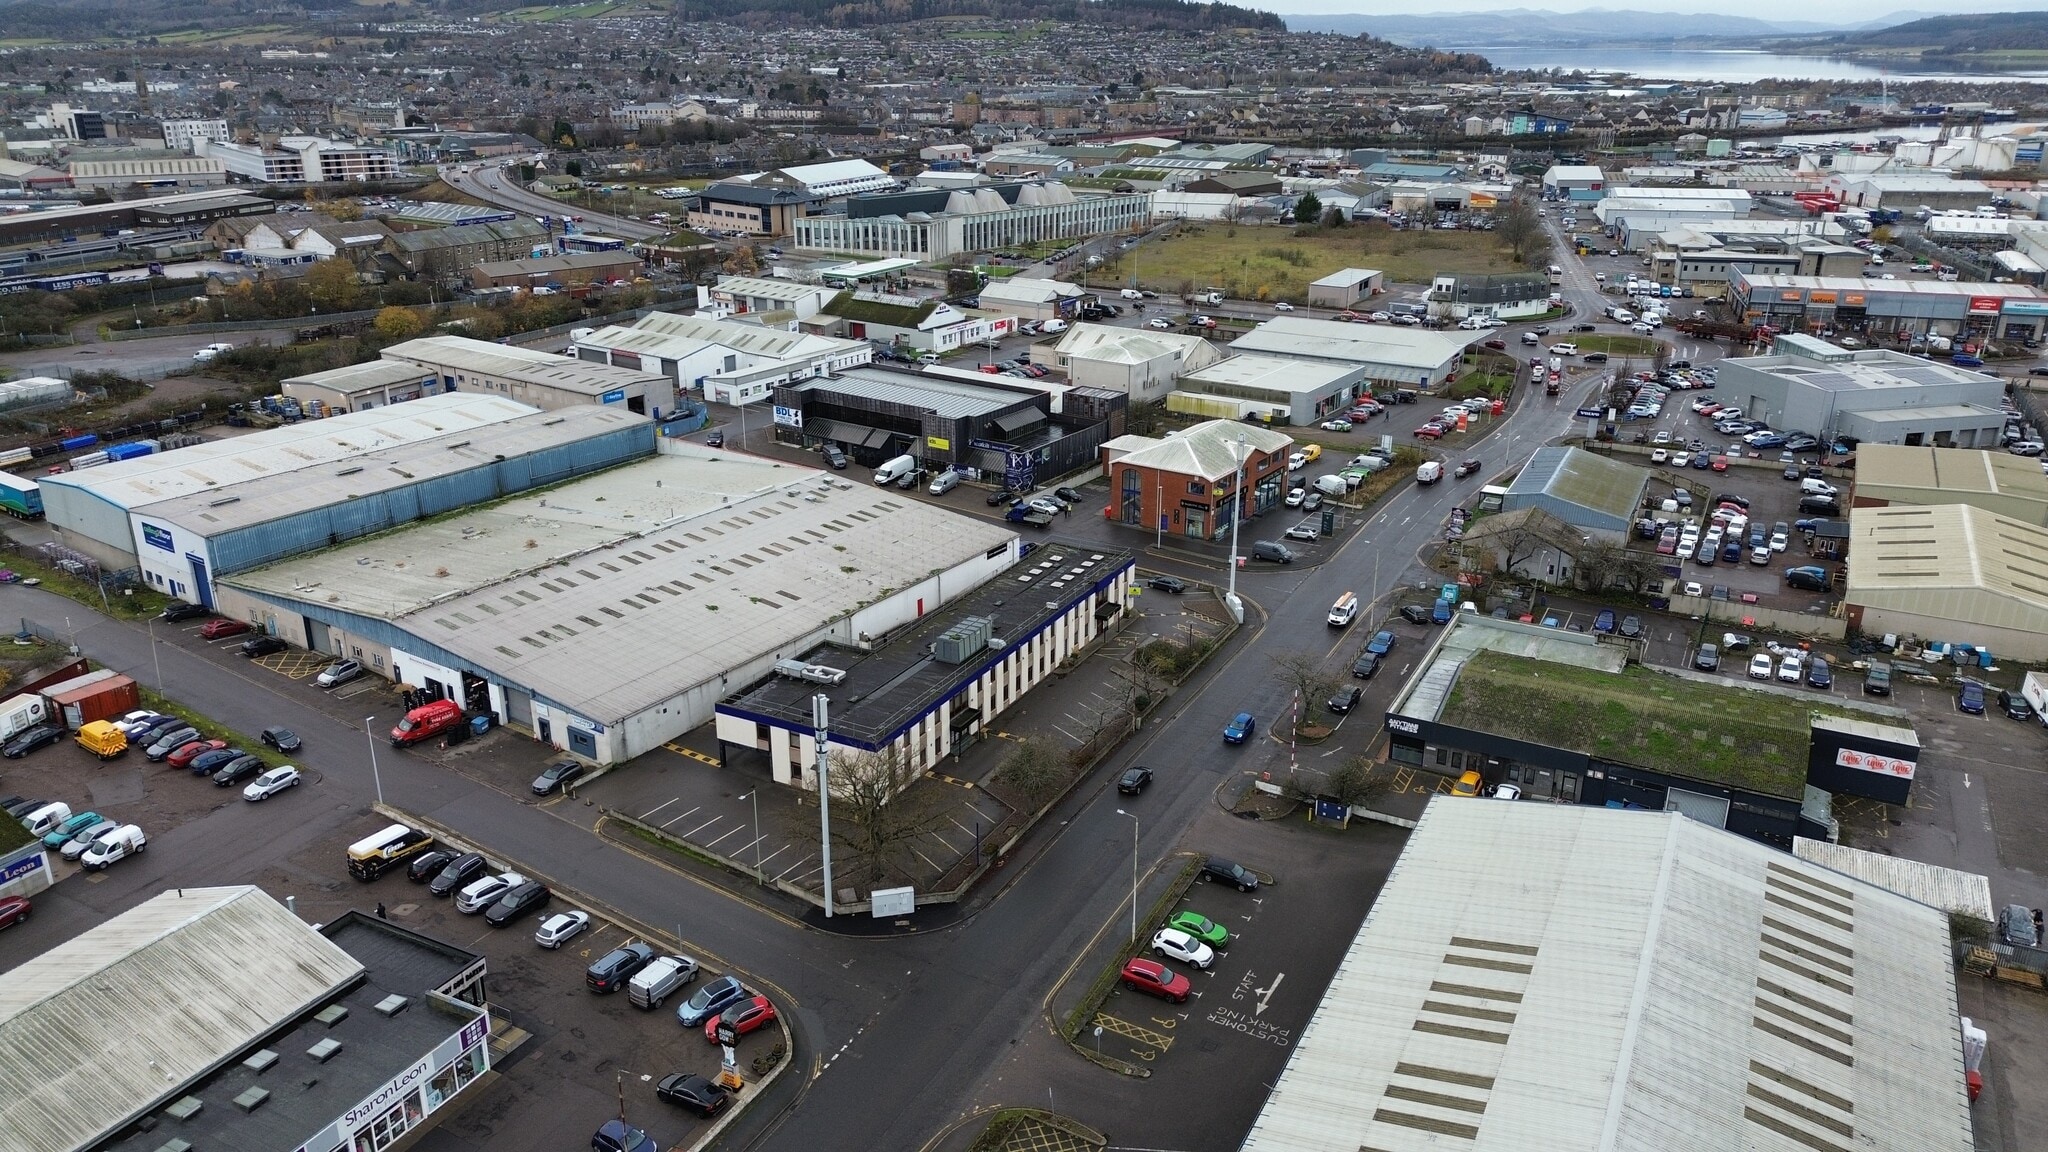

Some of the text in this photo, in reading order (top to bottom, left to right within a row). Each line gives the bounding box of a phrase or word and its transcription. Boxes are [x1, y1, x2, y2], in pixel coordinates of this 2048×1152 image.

[52, 280, 71, 288] LESS
[776, 406, 792, 417] BDL
[1388, 718, 1419, 730] ANYTIME
[1389, 724, 1418, 734] FITNESS
[1867, 759, 1885, 770] LOVE
[1892, 764, 1910, 775] LOVE
[4, 862, 36, 880] Leon
[1232, 969, 1257, 1001] STAFF
[1206, 1013, 1289, 1046] CUSTOMER
[1216, 1006, 1290, 1037] PARKING
[344, 1062, 427, 1127] Sharon Leon
